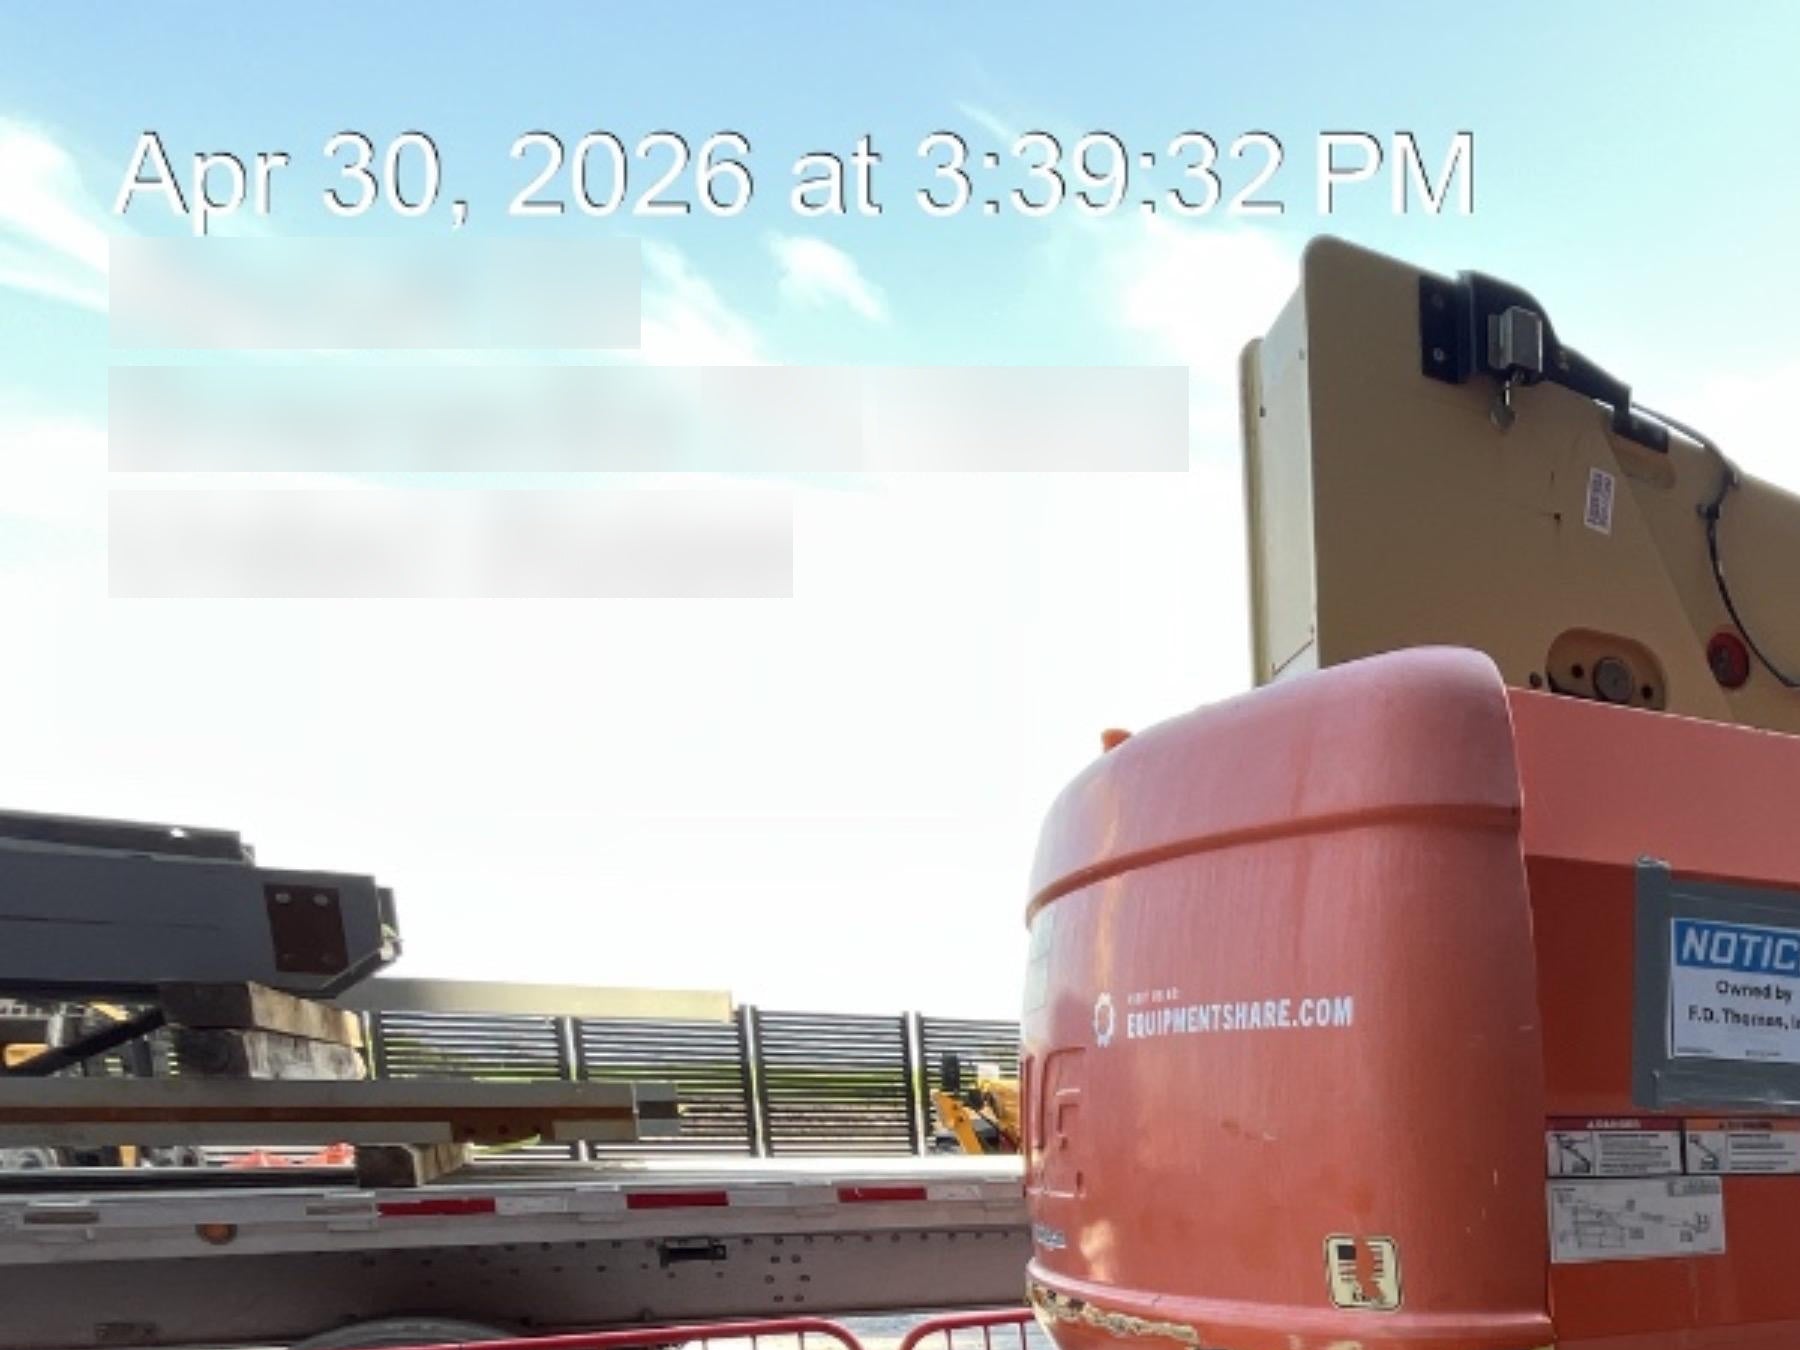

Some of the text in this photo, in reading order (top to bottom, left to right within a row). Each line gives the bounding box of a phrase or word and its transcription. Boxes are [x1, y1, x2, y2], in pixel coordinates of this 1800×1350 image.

[1715, 980, 1792, 1004] Owned by
[1126, 996, 1355, 1039] EQUIPMENTSHARE.COM
